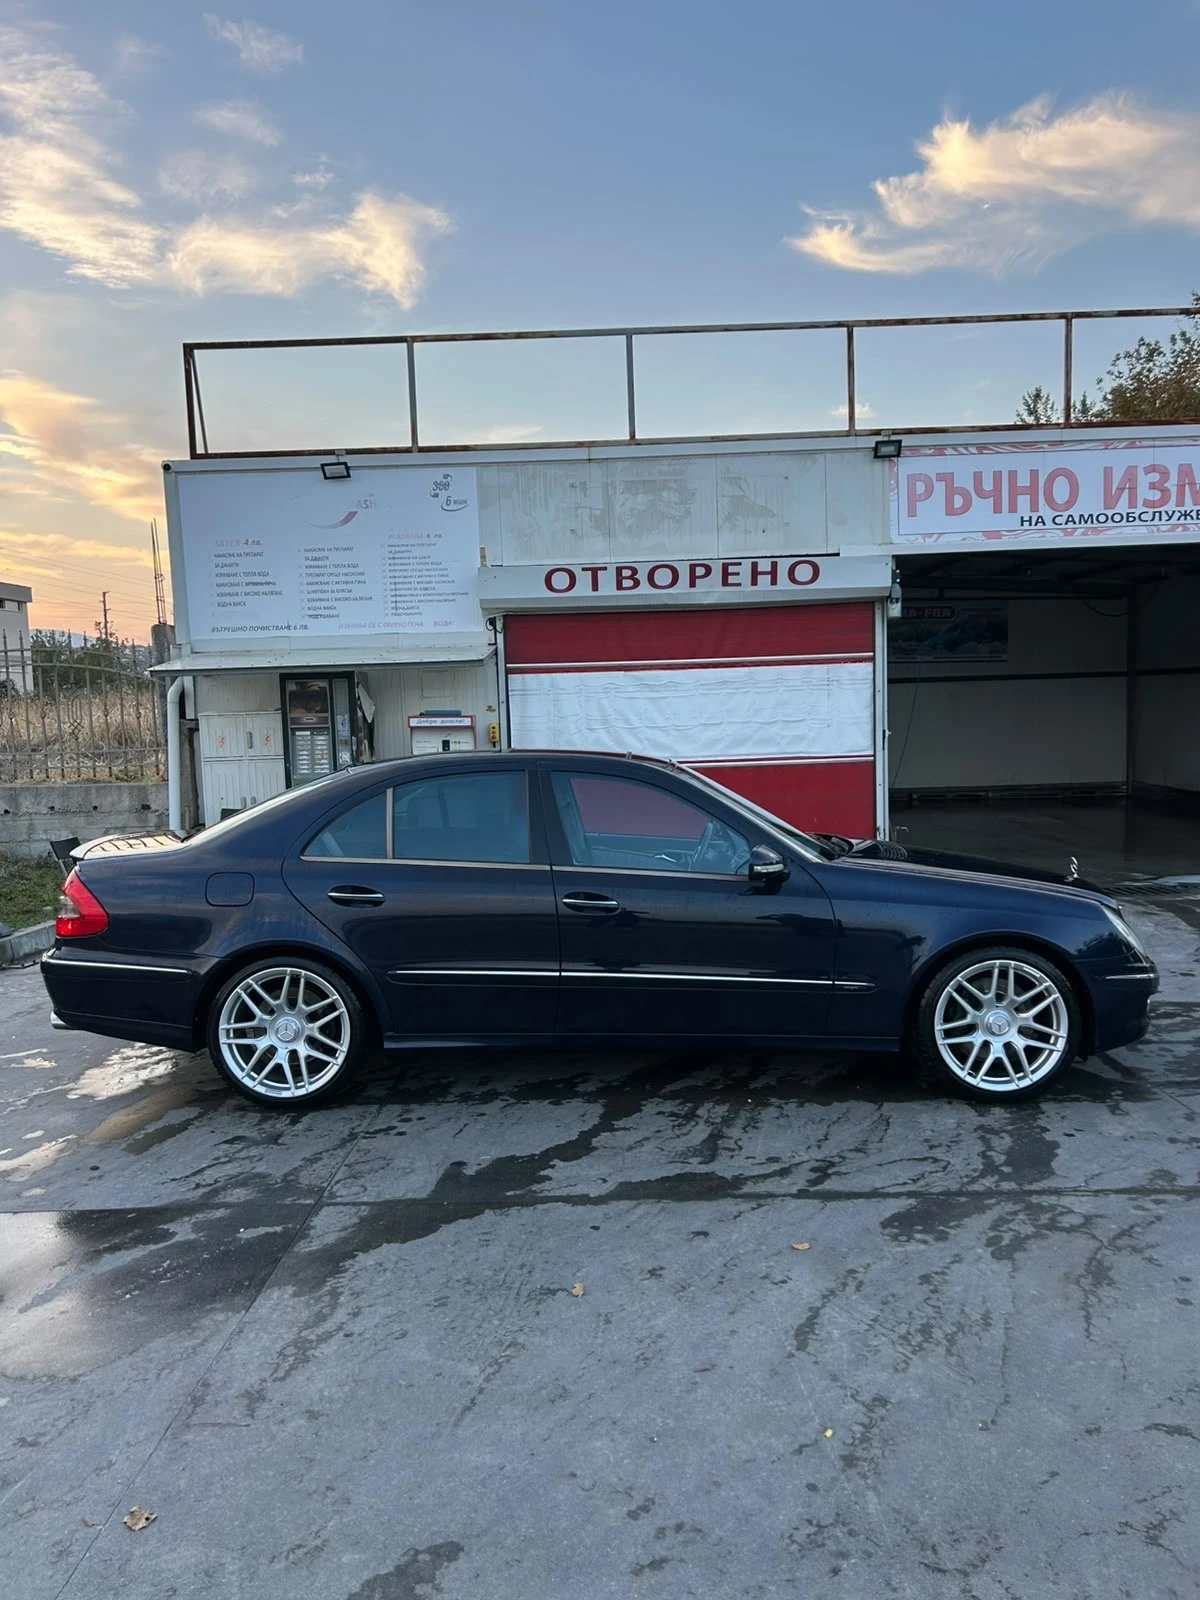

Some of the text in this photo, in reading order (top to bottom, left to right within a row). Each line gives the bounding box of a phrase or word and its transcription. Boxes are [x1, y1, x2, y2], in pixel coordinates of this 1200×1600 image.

[907, 467, 1080, 518] РЪЧНО
[445, 495, 452, 506] 6
[1020, 515, 1047, 528] НА
[544, 560, 821, 594] ОТВОРЕНО
[211, 625, 248, 633] ВЪТРЕШНО
[248, 624, 292, 632] ПОЧИСТВАНЕ
